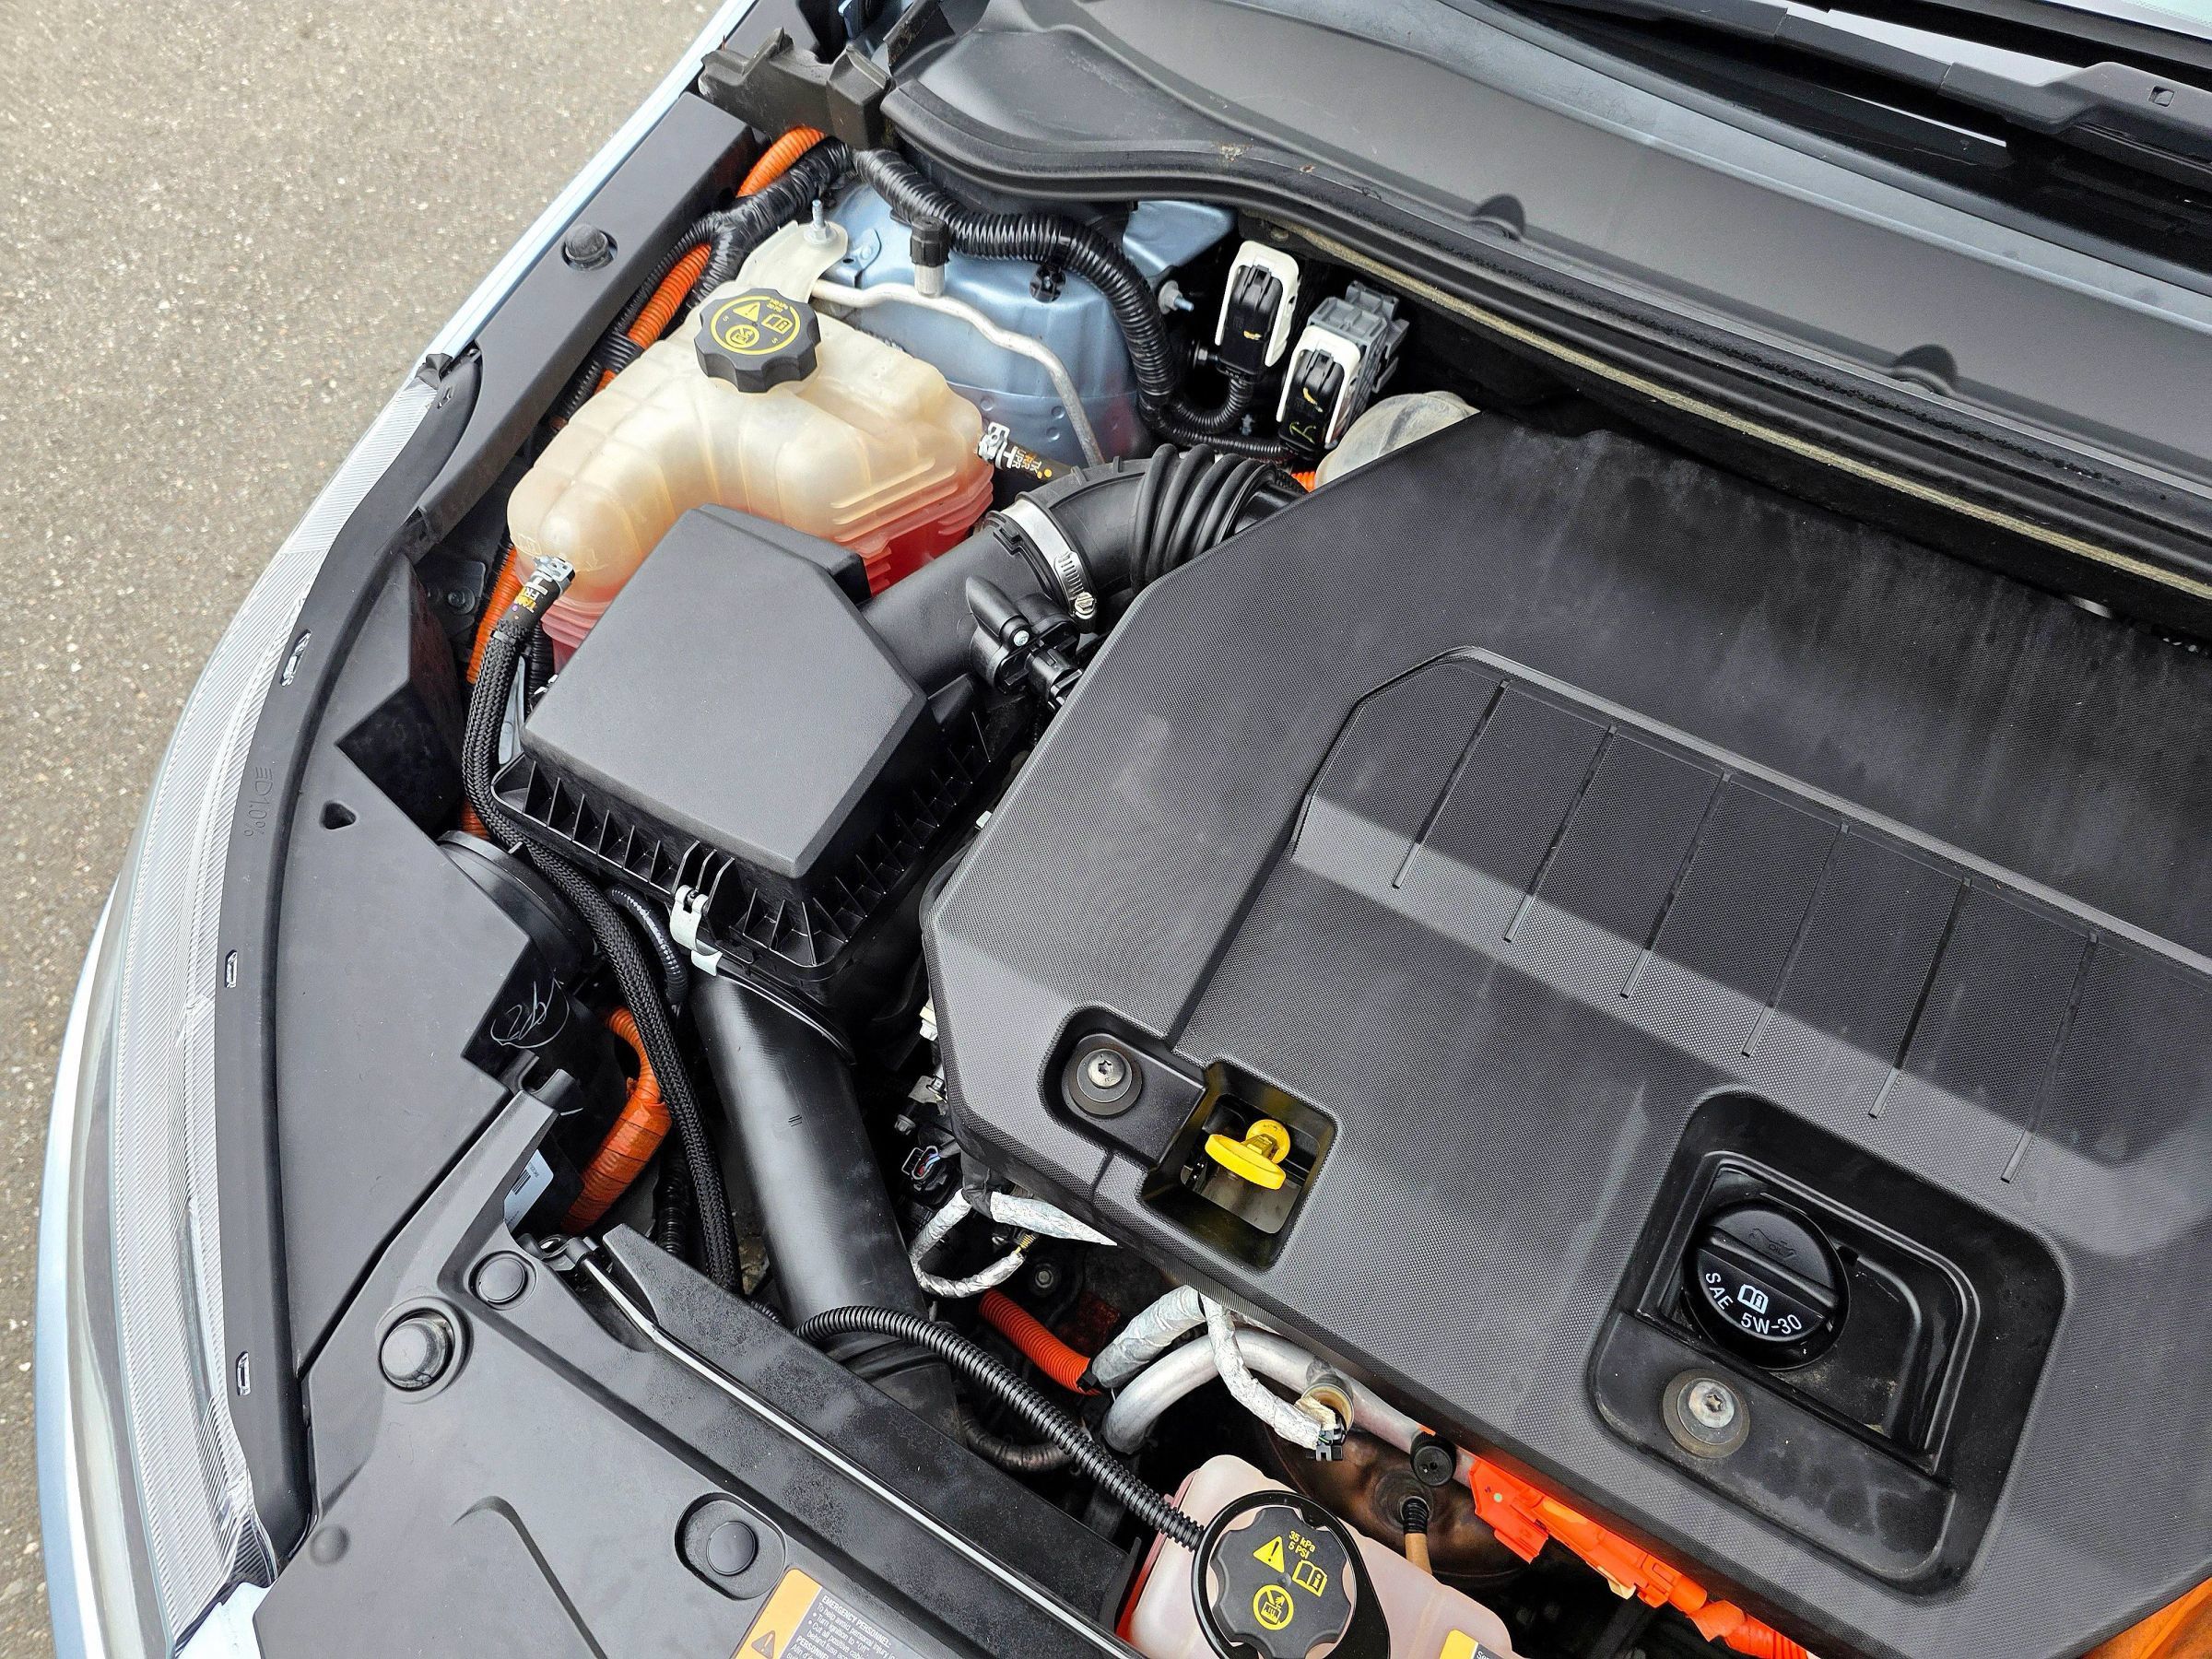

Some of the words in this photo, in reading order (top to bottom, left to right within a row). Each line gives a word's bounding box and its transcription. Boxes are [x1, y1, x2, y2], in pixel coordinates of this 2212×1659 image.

[1769, 1244, 1785, 1256] OIL
[1705, 1272, 1734, 1311] SAE
[1740, 1312, 1803, 1335] 5W-30
[1288, 1530, 1300, 1543] 35
[1300, 1536, 1316, 1553] kPa
[1288, 1541, 1295, 1550] 5
[1295, 1545, 1310, 1559] PSI
[816, 1614, 830, 1627] Turn
[828, 1623, 849, 1641] ignition
[848, 1637, 856, 1645] to
[816, 1603, 825, 1612] To
[823, 1608, 836, 1620] help
[835, 1618, 851, 1630] avoid
[850, 1628, 874, 1646] personal
[874, 1642, 889, 1658] injury
[821, 1595, 857, 1624] EMERGENCY
[855, 1619, 892, 1648] PERSONNEL:
[806, 1630, 826, 1647] behind
[825, 1642, 838, 1655] fuse
[811, 1622, 823, 1633] Cut
[821, 1630, 830, 1639] all
[828, 1635, 851, 1653] positive
